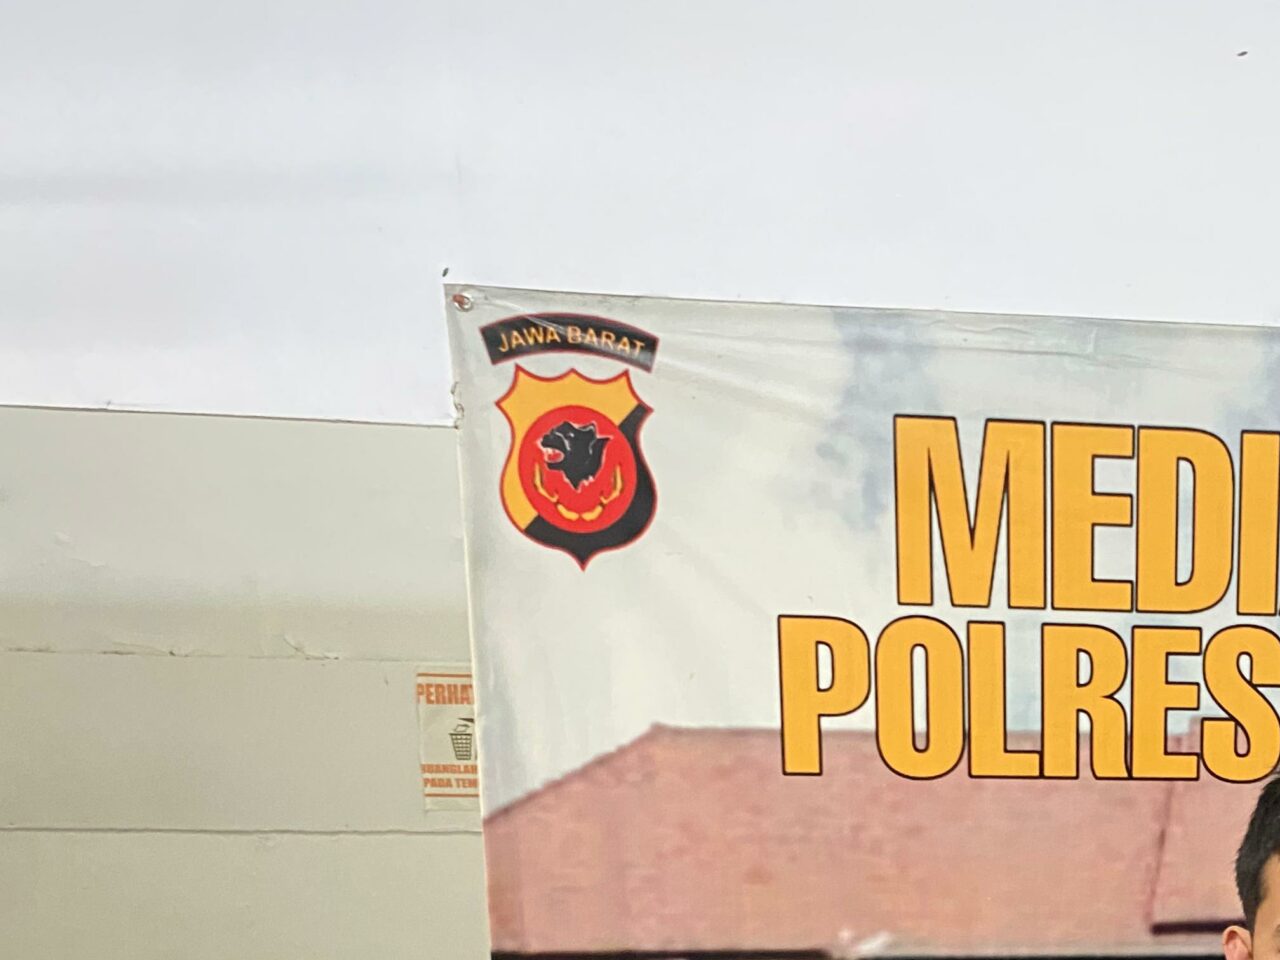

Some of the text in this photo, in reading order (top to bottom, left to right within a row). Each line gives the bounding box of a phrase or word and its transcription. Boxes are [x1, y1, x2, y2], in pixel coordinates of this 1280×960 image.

[499, 325, 645, 359] JAWA BARAT
[416, 683, 474, 705] PERHA
[424, 778, 453, 789] PADA
